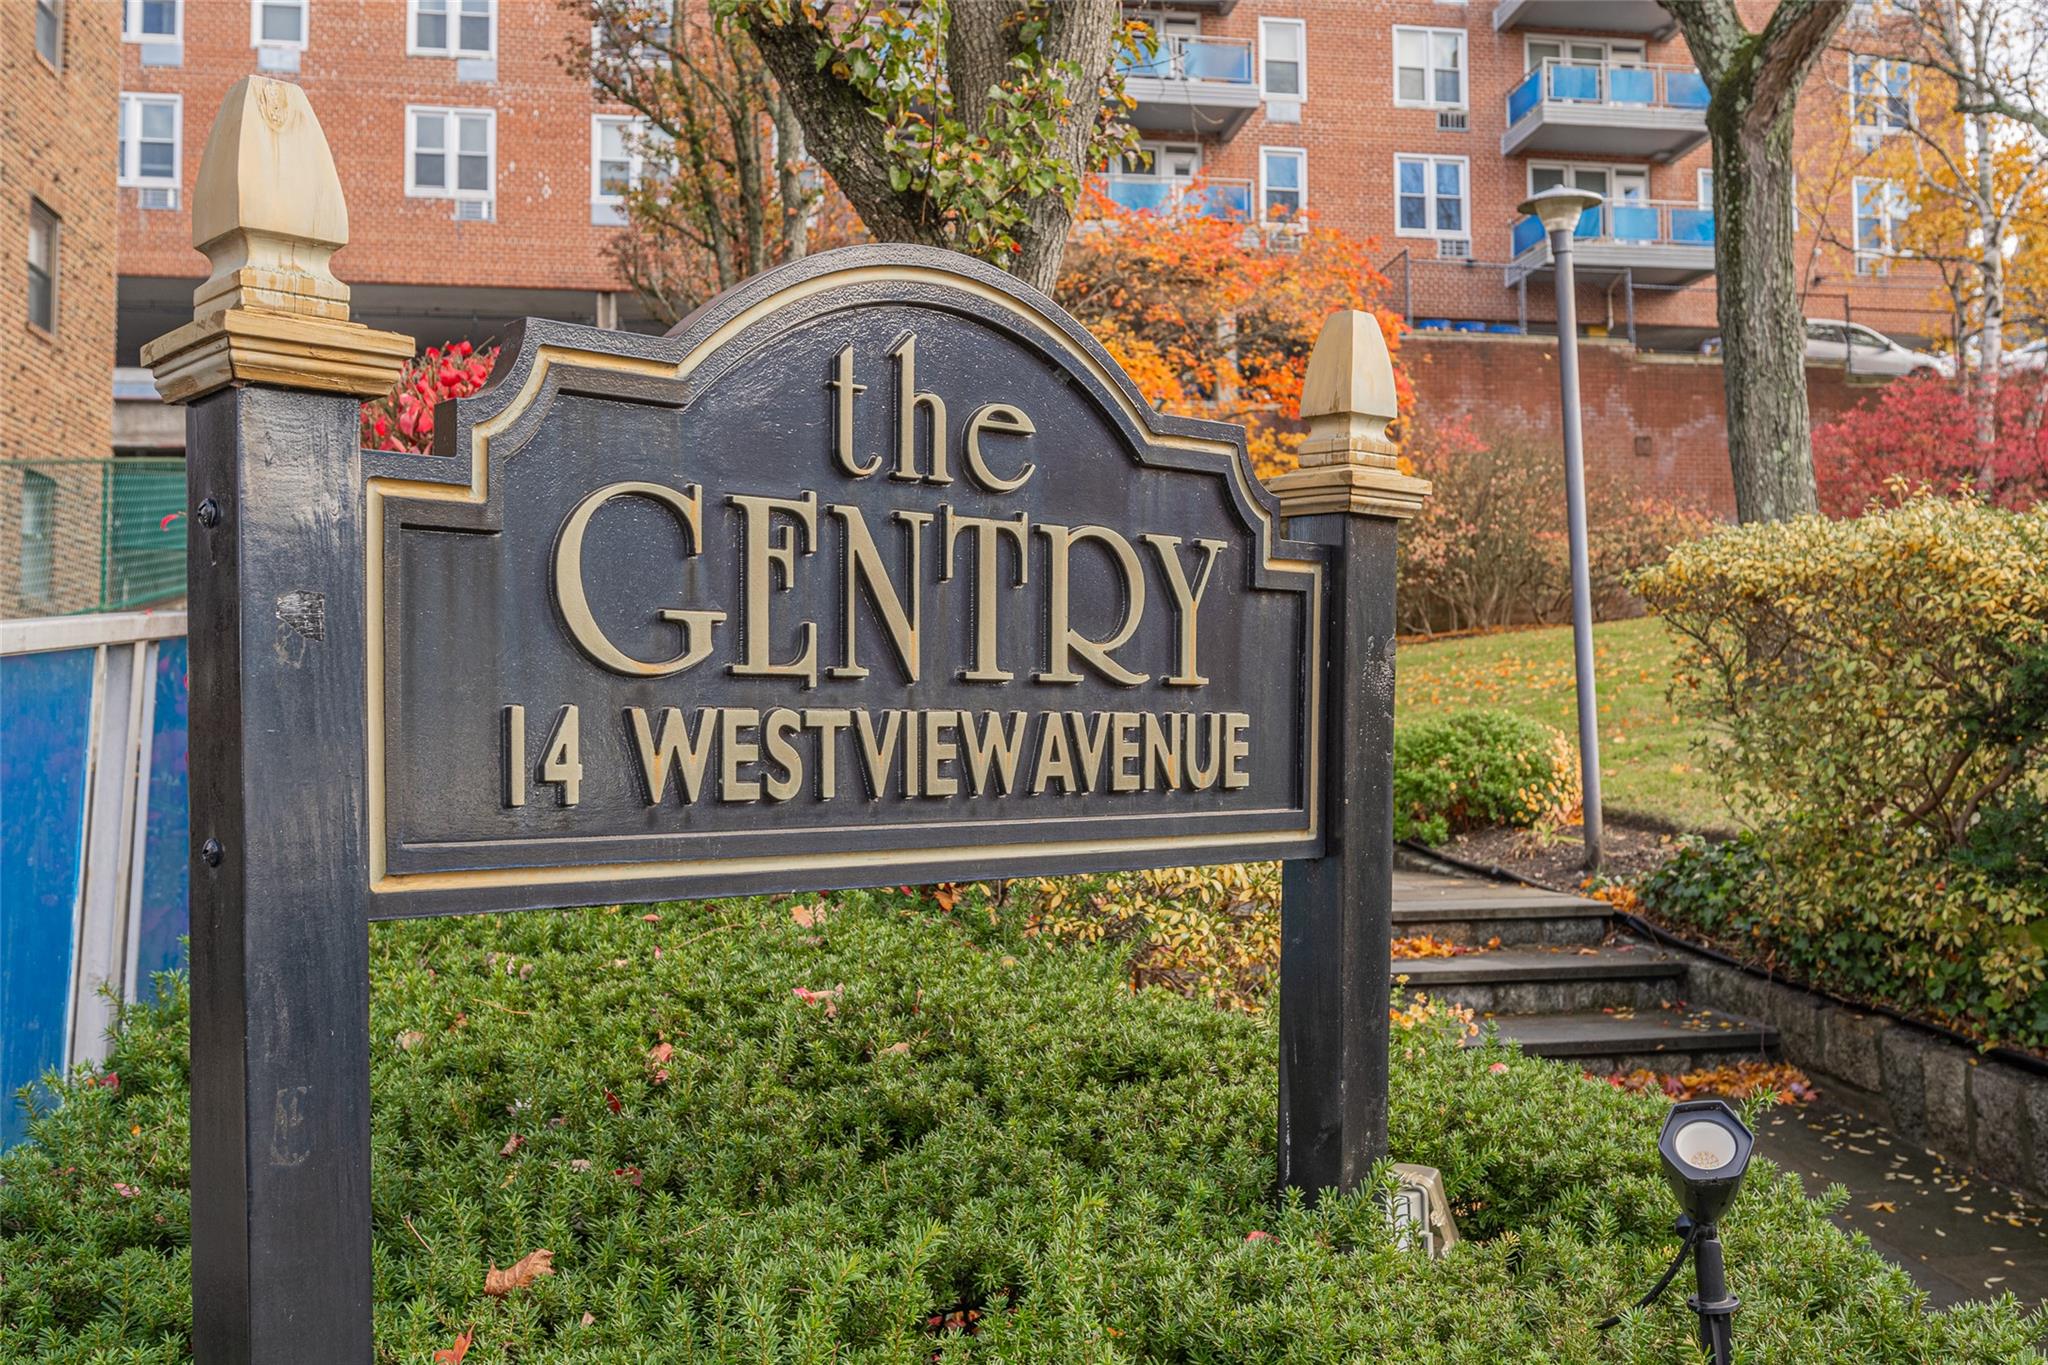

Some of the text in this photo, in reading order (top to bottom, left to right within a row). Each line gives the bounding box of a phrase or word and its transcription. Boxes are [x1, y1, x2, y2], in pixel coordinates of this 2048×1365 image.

[832, 331, 1036, 493] the
[551, 481, 1228, 689] GENTRY
[505, 704, 583, 807] 14
